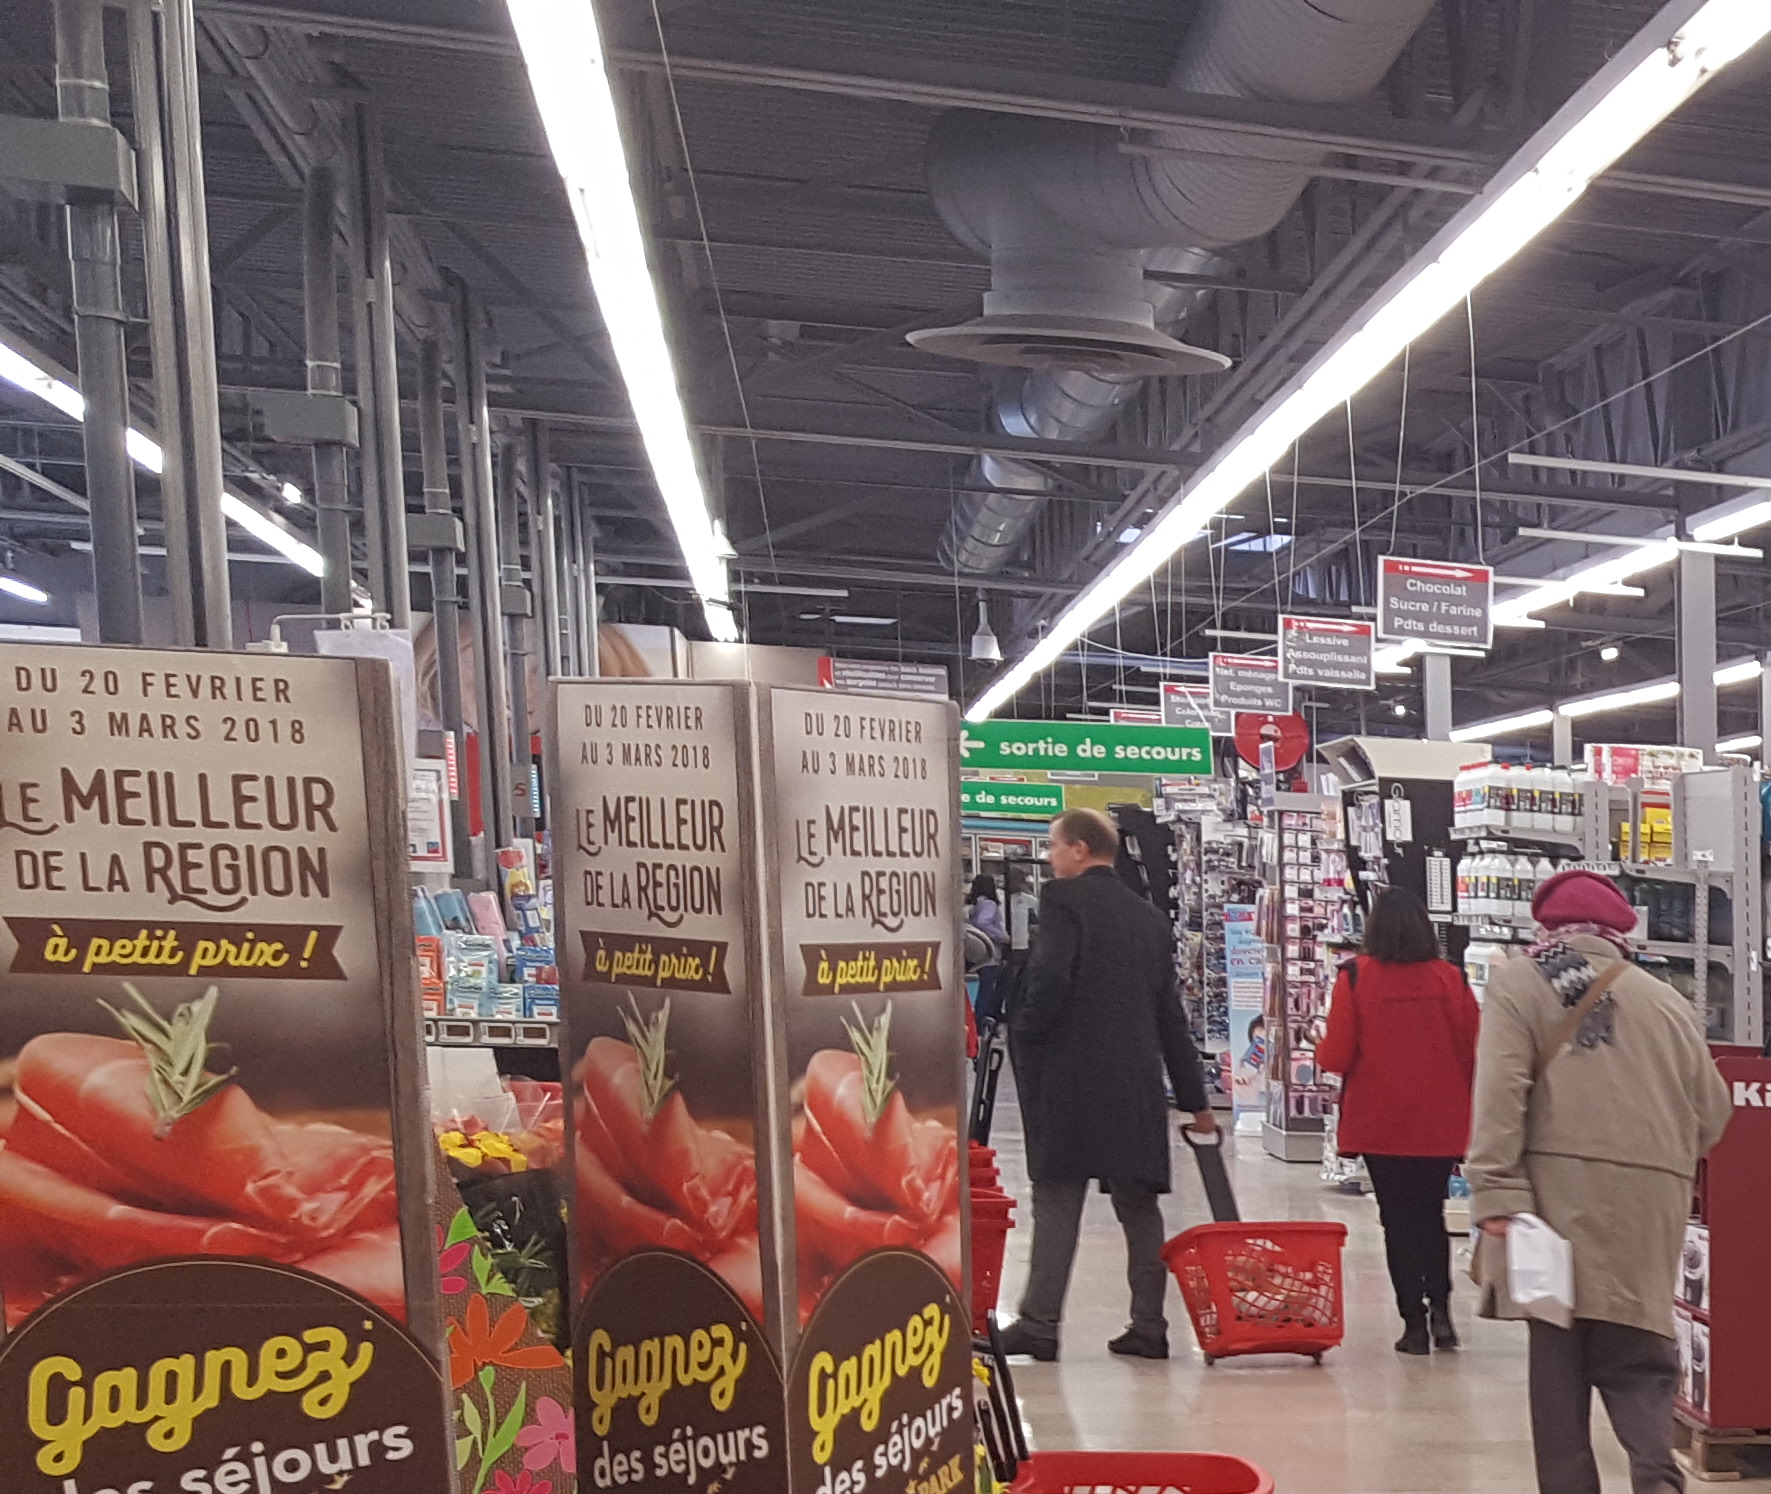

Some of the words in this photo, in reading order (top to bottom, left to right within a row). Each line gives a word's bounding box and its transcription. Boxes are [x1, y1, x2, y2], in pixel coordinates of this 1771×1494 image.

[1390, 597, 1429, 612] Sucre
[1441, 602, 1482, 617] Farine
[1406, 579, 1467, 596] Chocolat
[1306, 633, 1349, 647] Lessive
[1394, 617, 1424, 631] Pdts
[1429, 621, 1478, 636] dessert
[1288, 650, 1367, 664] Assouplissant
[1316, 667, 1367, 680] vaisselle
[15, 666, 59, 693] DU
[81, 669, 120, 697] 20
[141, 672, 292, 703] FEVRIER
[7, 707, 48, 734] AU
[70, 710, 86, 736] 3
[108, 712, 202, 740] MARS
[222, 717, 306, 744] 2018
[584, 704, 601, 729] DU
[611, 705, 628, 729] 20
[636, 705, 703, 731] FEVRIER
[580, 741, 598, 765] AU
[606, 742, 614, 766] 3
[622, 743, 663, 768] MARS
[671, 745, 710, 770] 2018
[1000, 738, 1068, 757] sortie
[1077, 738, 1105, 758] de
[1115, 743, 1202, 762] secours
[61, 767, 338, 833] MEILLEUR
[976, 791, 995, 804] de
[1001, 794, 1057, 807] secours
[576, 808, 602, 857] LE
[602, 795, 726, 853] MEILLEUR
[796, 819, 825, 868] LE
[825, 804, 941, 858] MEILLEUR
[14, 849, 66, 891] DE
[80, 852, 130, 893] LA
[142, 841, 330, 912] REGION
[584, 870, 605, 908] DE
[610, 871, 632, 909] LA
[636, 862, 723, 928] REGION
[804, 881, 828, 919] DE
[834, 883, 855, 919] LA
[860, 870, 938, 933] REGION
[44, 924, 77, 962] à
[83, 929, 184, 973] petit
[188, 931, 290, 976] prix
[596, 938, 609, 971] à
[611, 943, 655, 984] petit
[656, 946, 703, 988] prix
[28, 1324, 374, 1477] Gagnez
[588, 1322, 747, 1436] Gagnez
[808, 1302, 950, 1464] Gagnez
[873, 1386, 964, 1475] séjours
[594, 1441, 643, 1489] des
[653, 1423, 769, 1486] séjours
